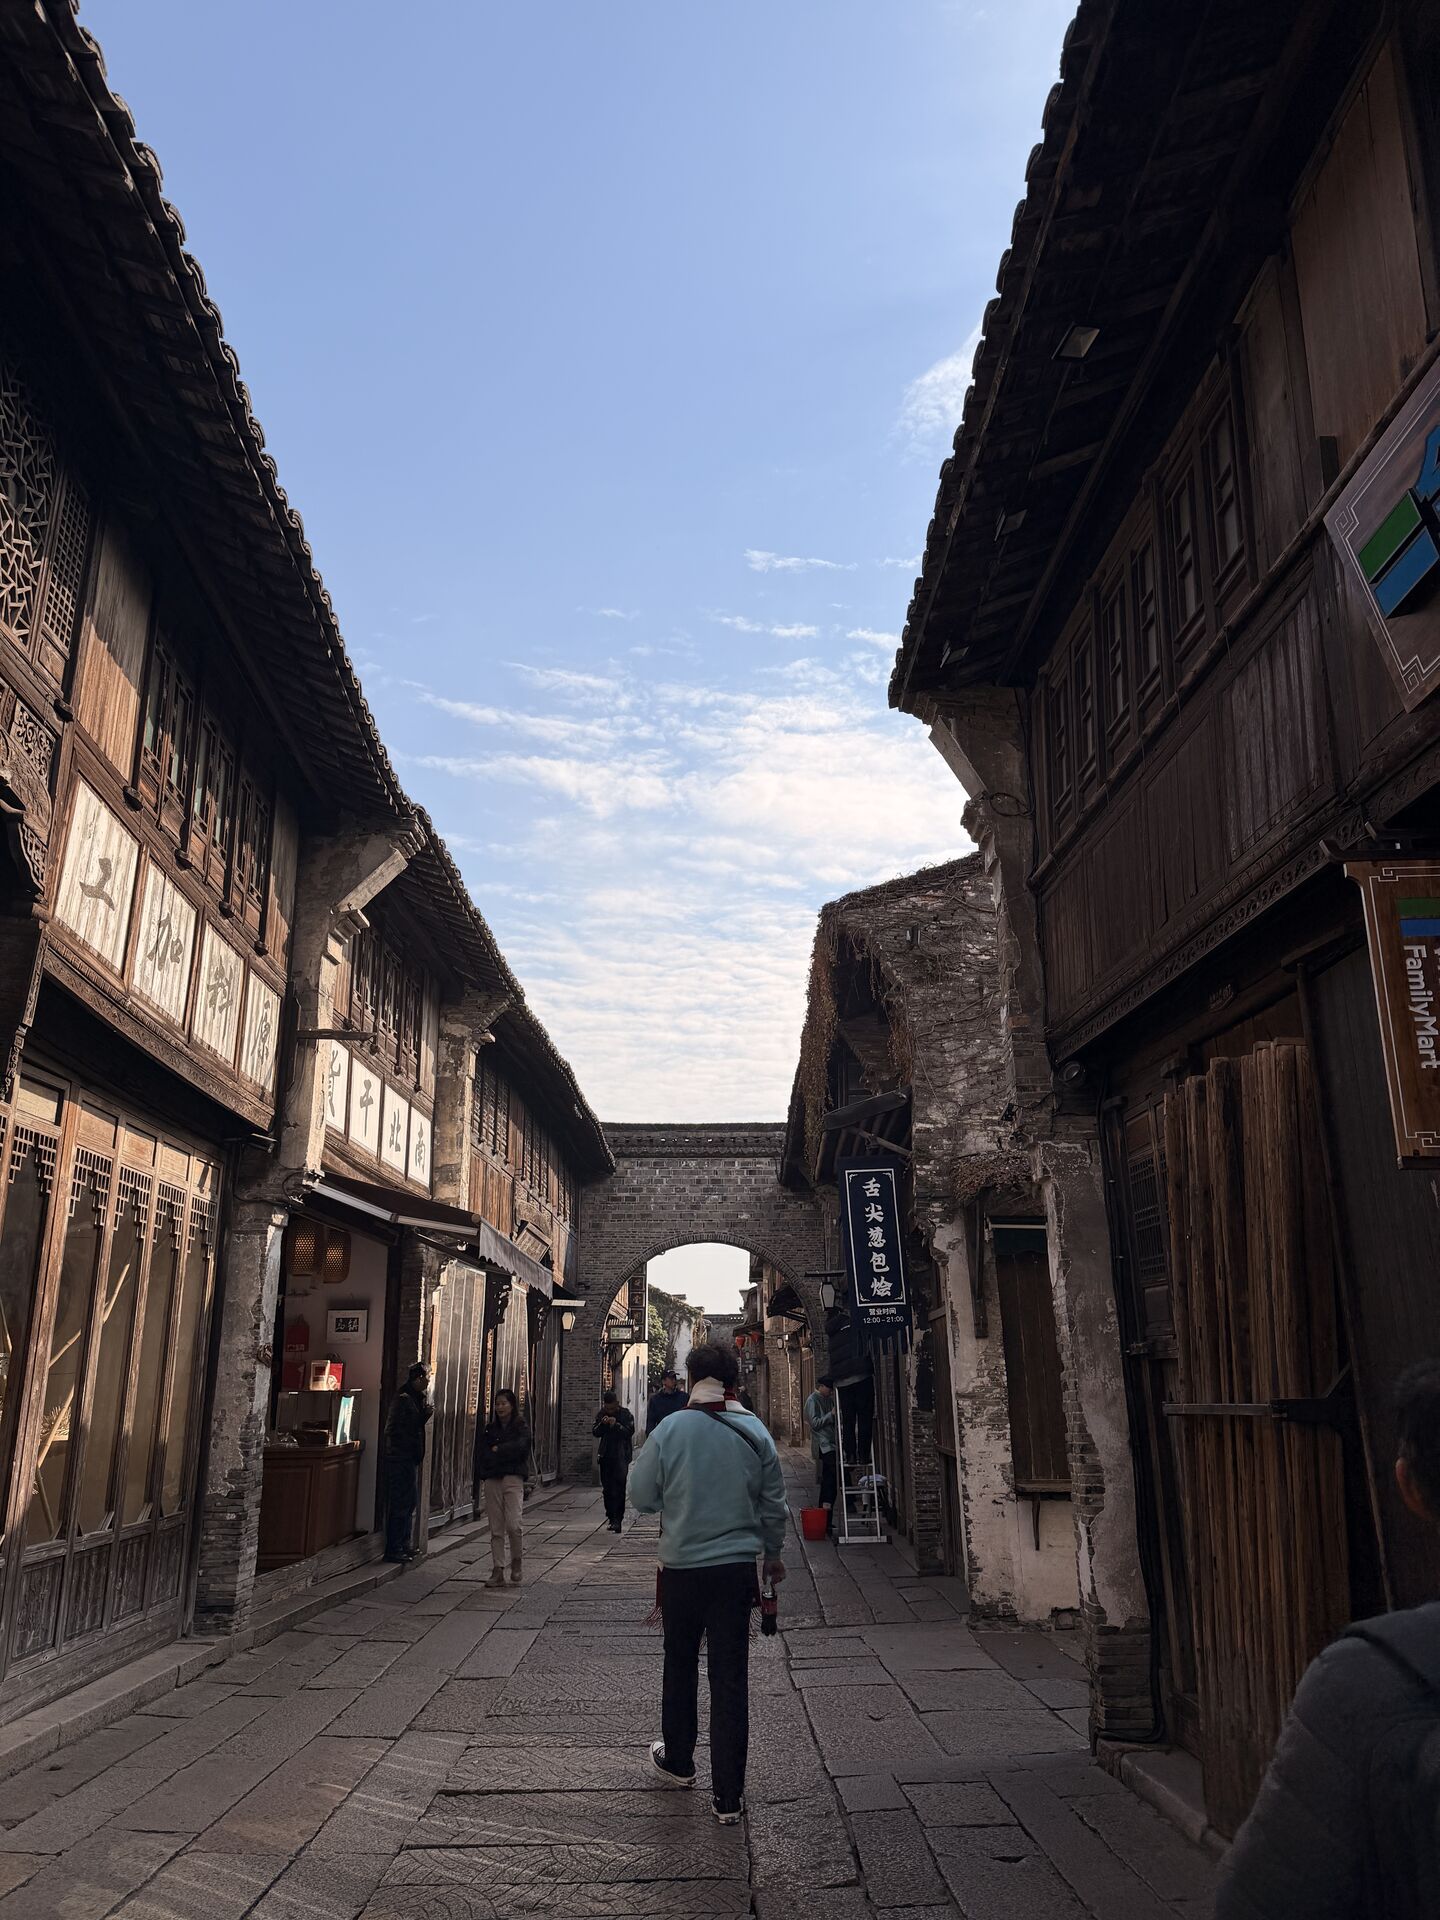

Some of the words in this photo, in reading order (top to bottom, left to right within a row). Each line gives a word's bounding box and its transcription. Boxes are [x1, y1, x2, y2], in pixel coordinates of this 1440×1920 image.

[1403, 944, 1439, 1069] FamilyMart
[862, 1177, 893, 1298] 舌尖葱包烩
[868, 1307, 897, 1316] 营业时间
